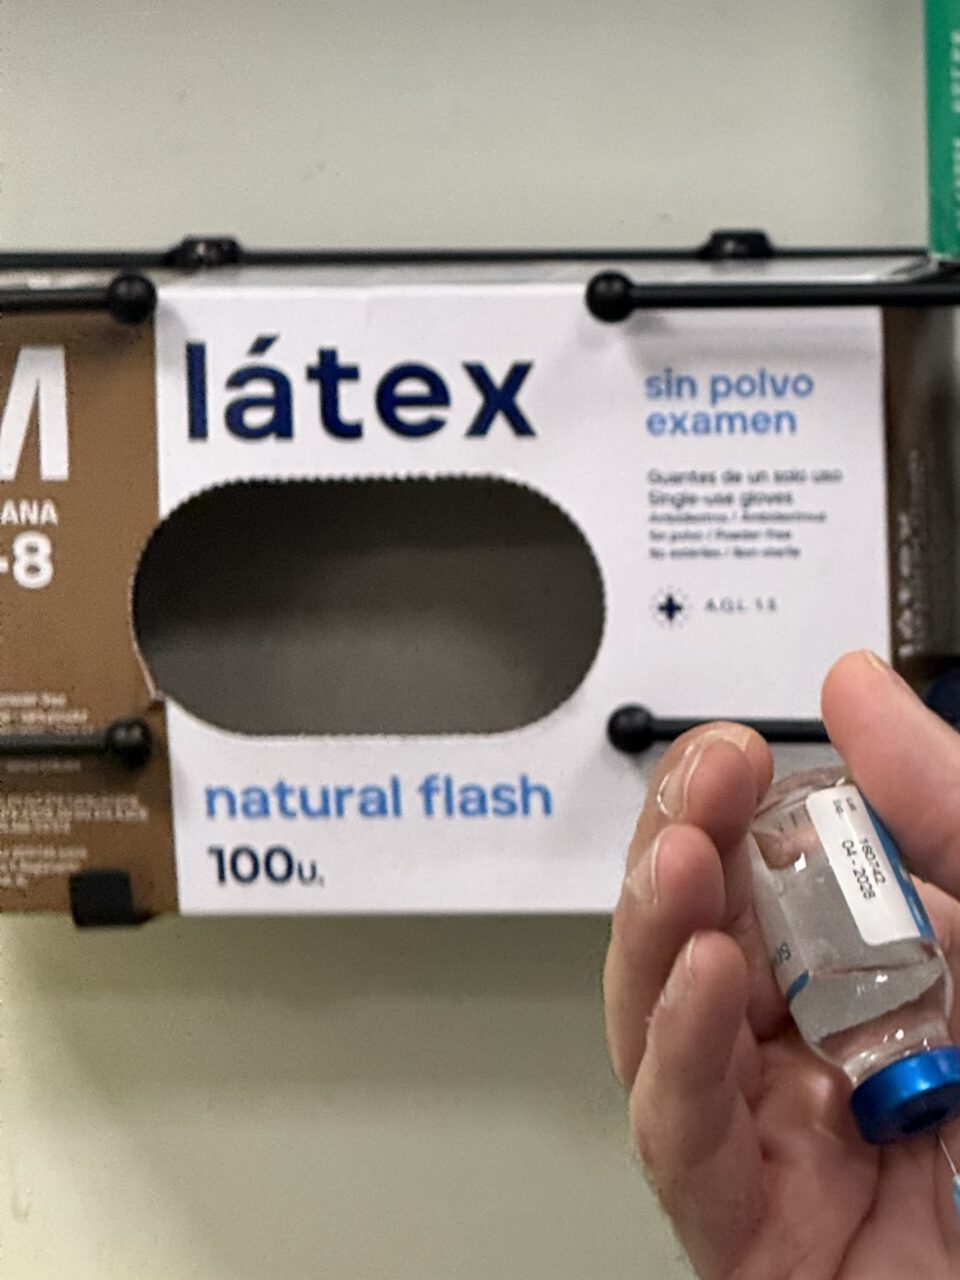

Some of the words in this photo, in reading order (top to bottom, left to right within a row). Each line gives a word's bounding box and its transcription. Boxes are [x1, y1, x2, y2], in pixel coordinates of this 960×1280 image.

[185, 334, 538, 443] látex
[645, 366, 697, 399] sin
[709, 366, 814, 407] polvo
[646, 409, 798, 436] examen
[0, 500, 58, 525] ANA
[0, 530, 54, 589] -8
[205, 774, 402, 819] natural
[420, 773, 554, 817] flash
[208, 844, 325, 887] 100u.
